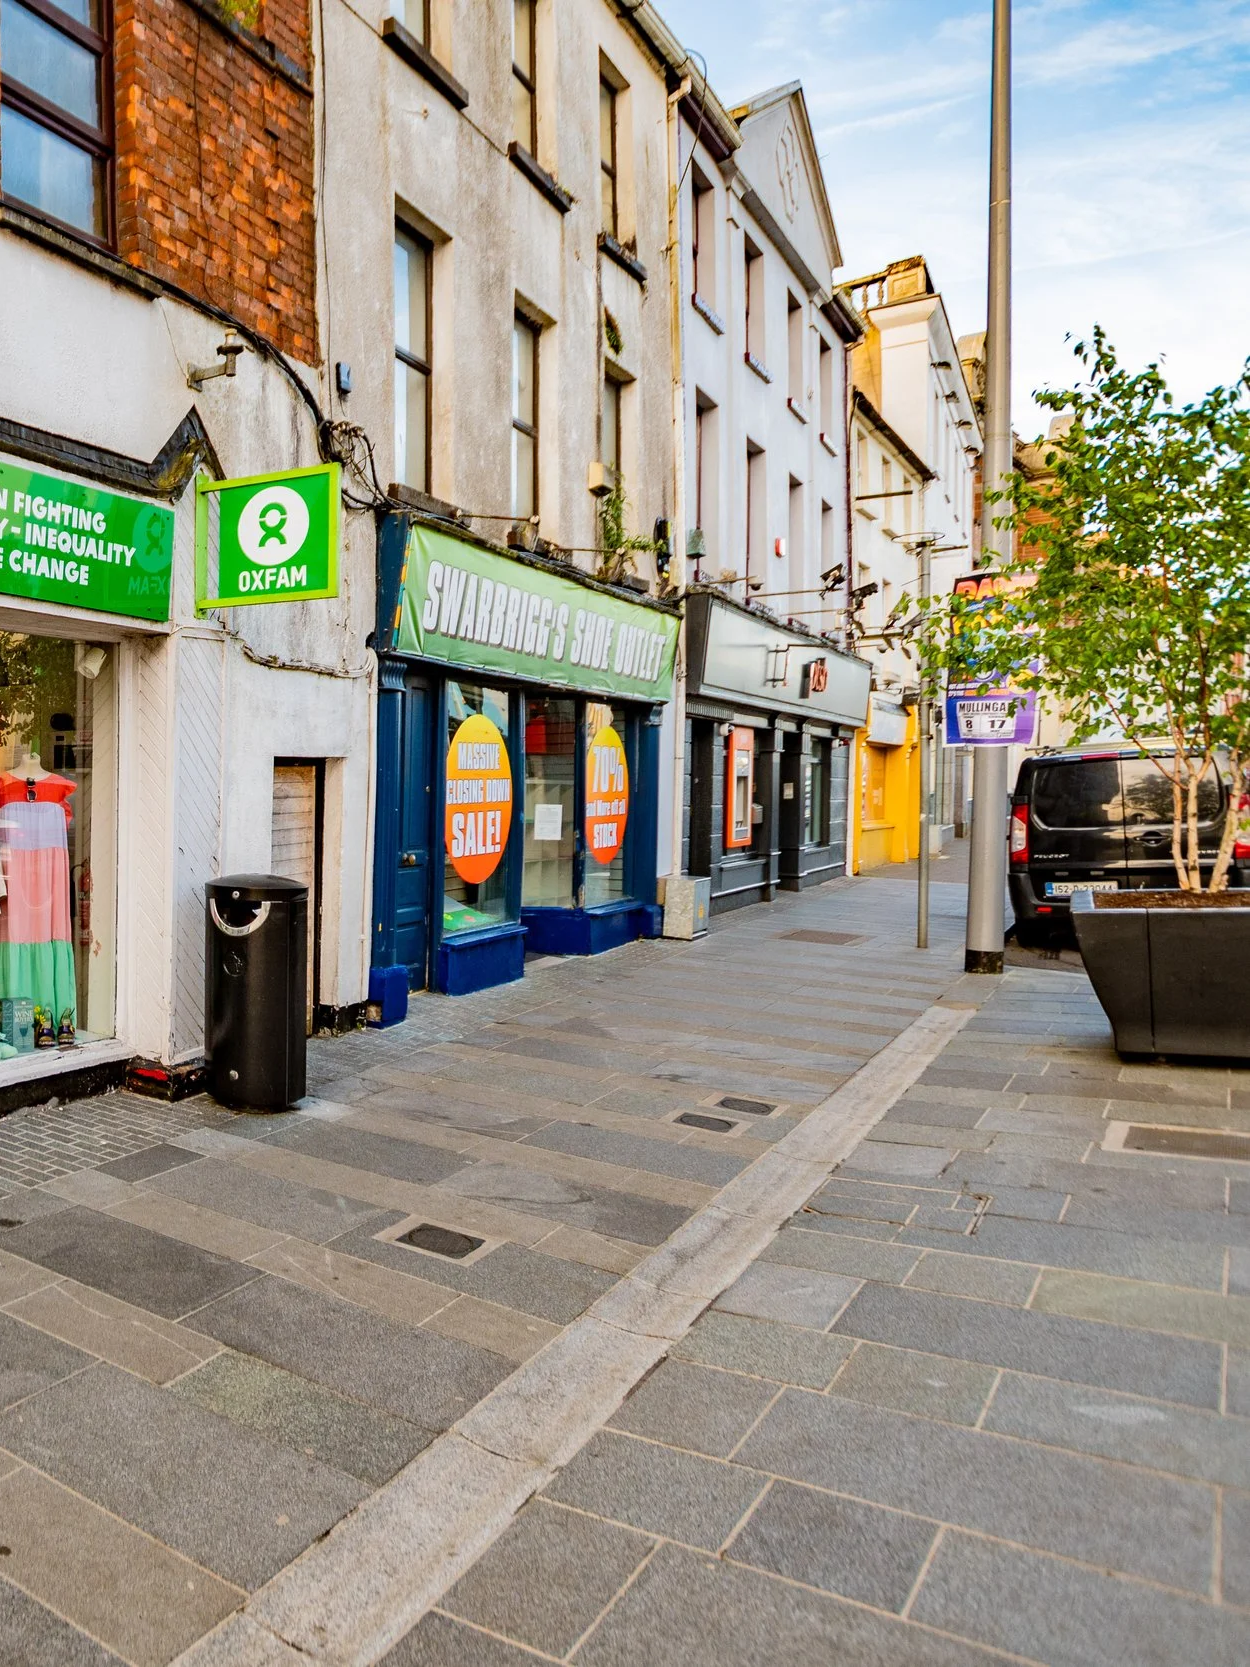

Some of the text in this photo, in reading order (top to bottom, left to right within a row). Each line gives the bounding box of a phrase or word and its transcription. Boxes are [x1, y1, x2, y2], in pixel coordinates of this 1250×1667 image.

[13, 491, 107, 534] FIGHTING
[25, 523, 136, 567] INEQUALITY
[9, 549, 89, 586] CHANGE
[238, 564, 307, 592] OXFAM
[422, 560, 668, 683] SWARBRIGG'S SHOE OUTLET
[959, 702, 1010, 713] MULLINGA
[965, 719, 1006, 729] 8 17
[458, 742, 500, 770] MASSIVE
[593, 745, 623, 794] 70%
[446, 778, 510, 805] CLOSING DOWN
[452, 810, 501, 859] SALE!
[593, 822, 617, 850] STOCK
